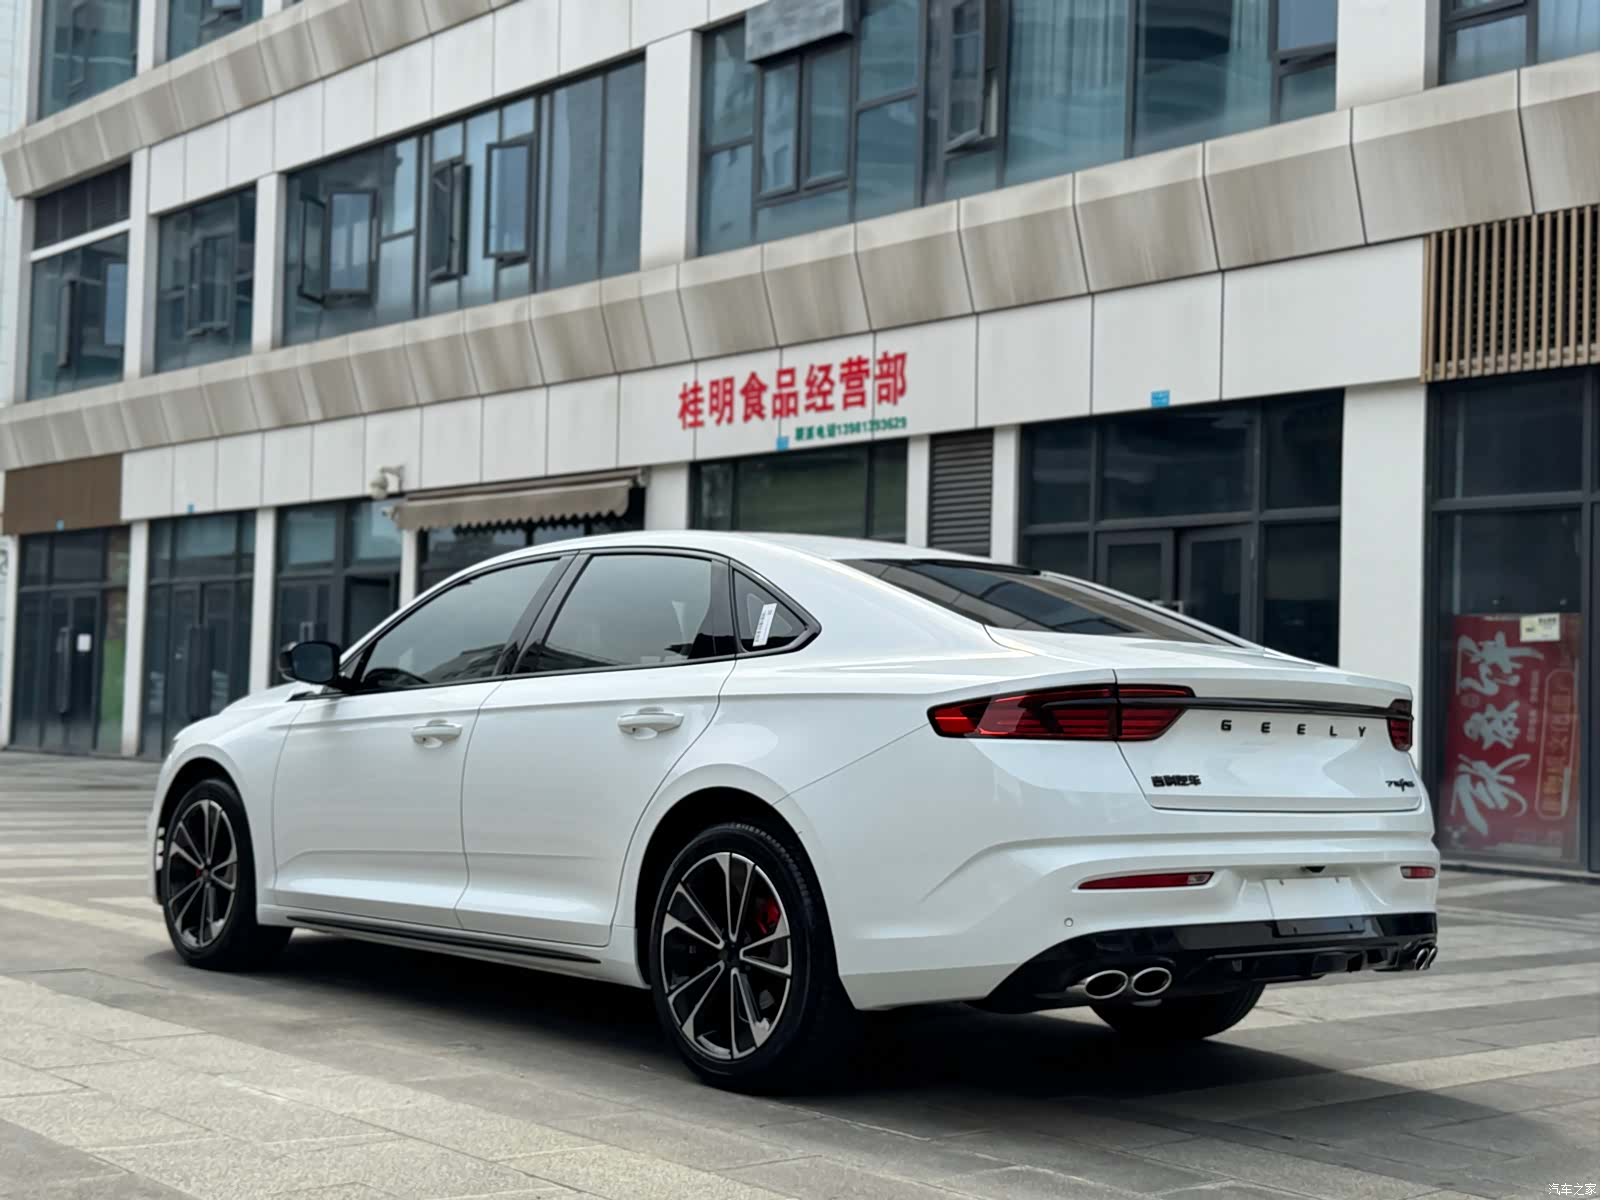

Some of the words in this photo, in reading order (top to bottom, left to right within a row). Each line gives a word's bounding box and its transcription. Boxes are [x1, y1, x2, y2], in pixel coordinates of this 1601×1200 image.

[678, 351, 907, 429] 桂明食品经营部
[1221, 719, 1366, 737] GEELY
